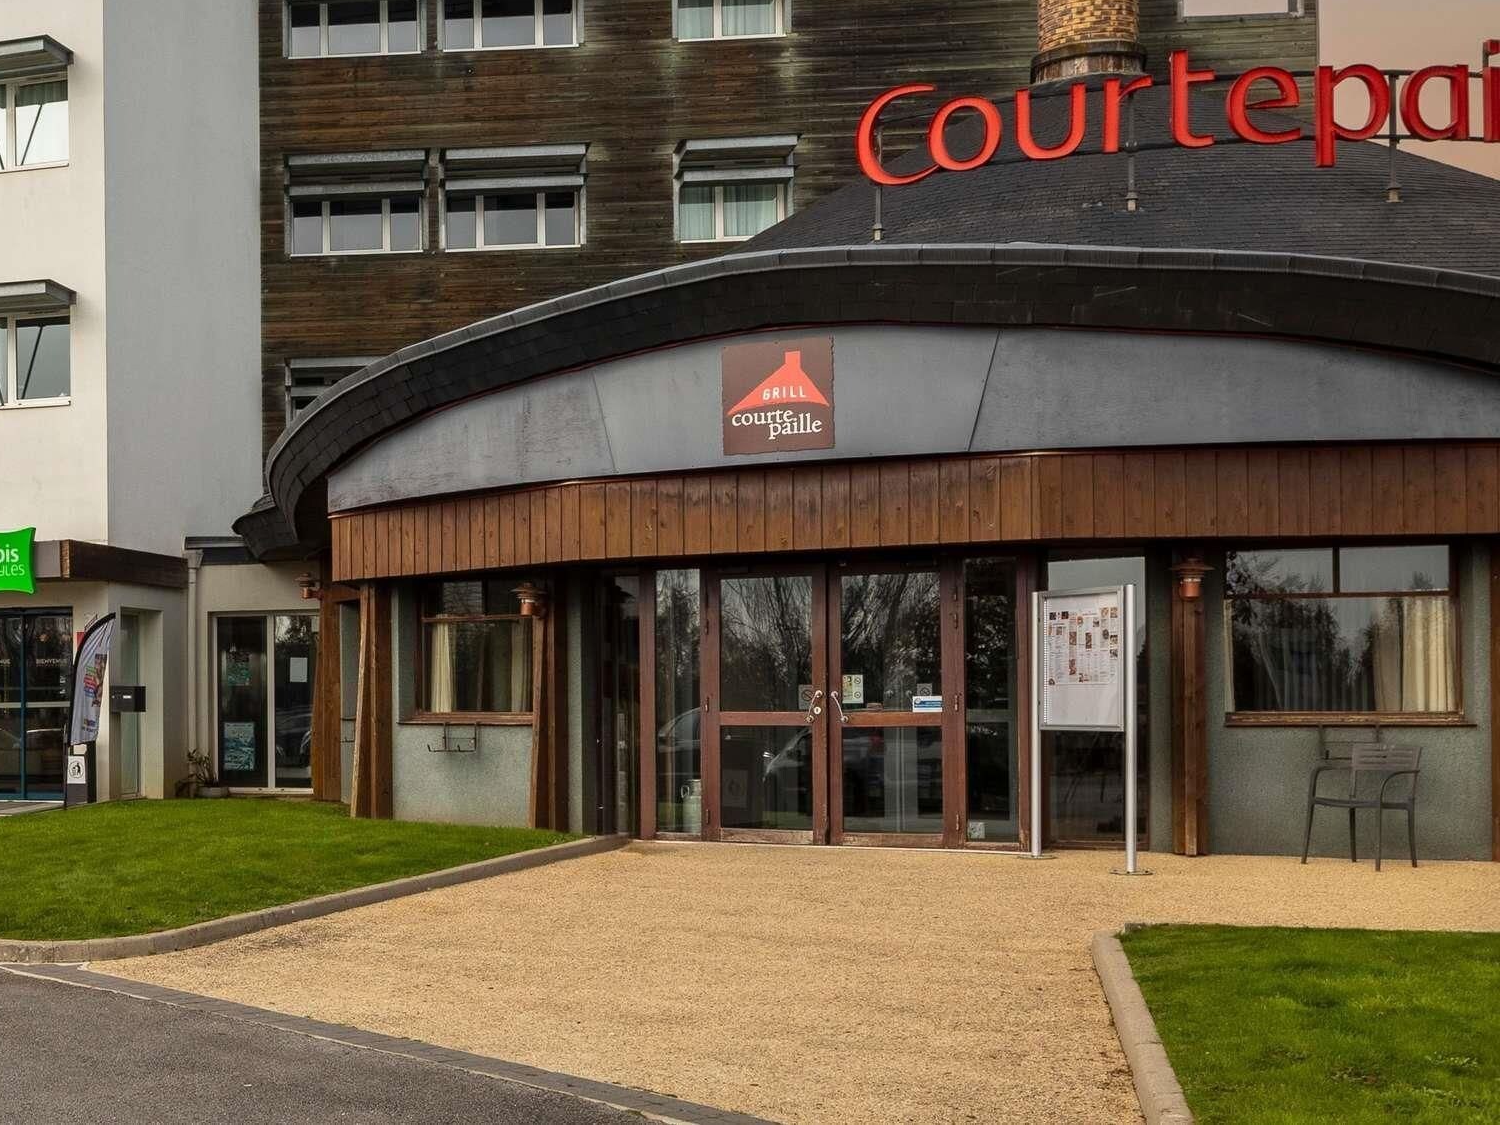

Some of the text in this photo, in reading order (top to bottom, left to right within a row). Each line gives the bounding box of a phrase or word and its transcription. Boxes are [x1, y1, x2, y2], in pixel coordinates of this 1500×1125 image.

[762, 385, 807, 401] GRILL
[731, 409, 795, 427] courte
[768, 412, 823, 440] paille
